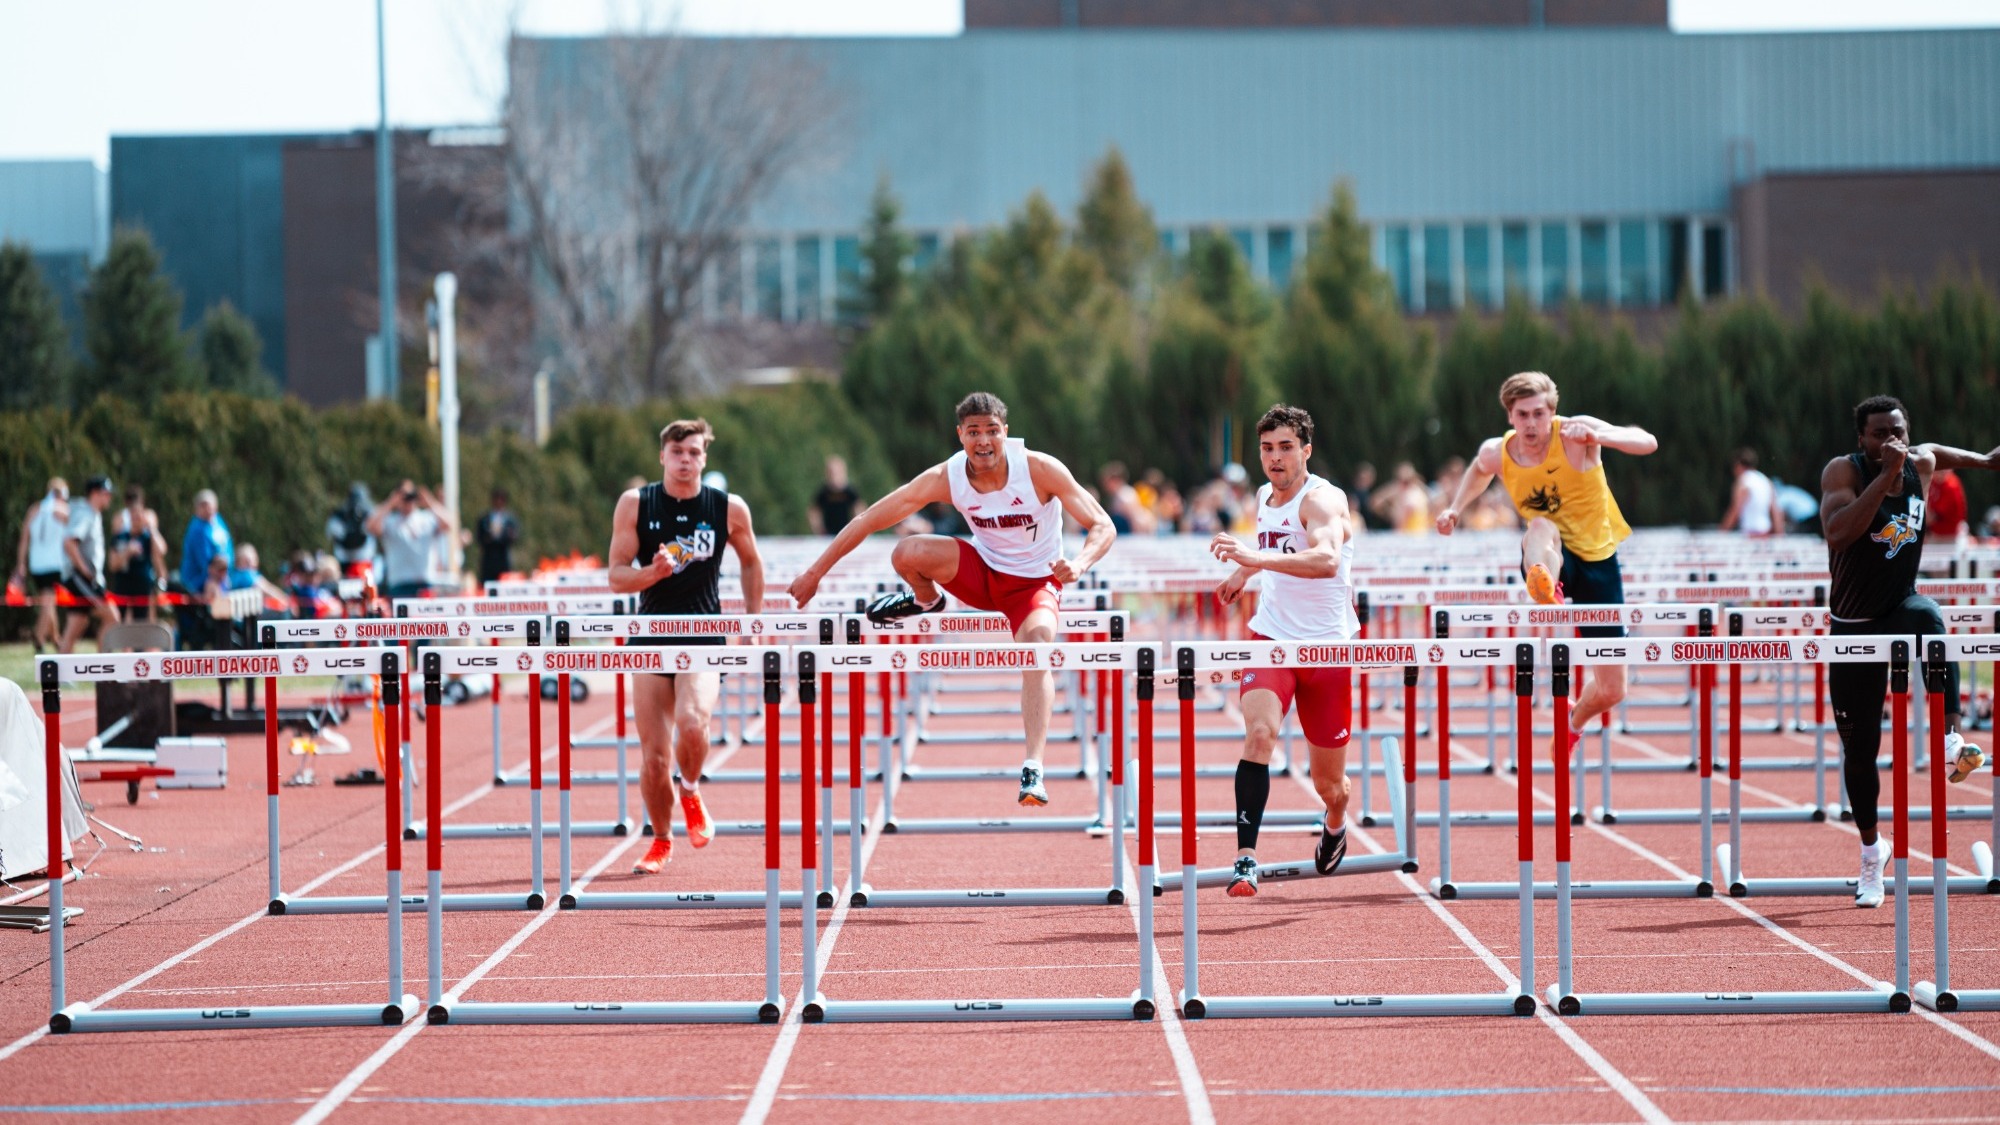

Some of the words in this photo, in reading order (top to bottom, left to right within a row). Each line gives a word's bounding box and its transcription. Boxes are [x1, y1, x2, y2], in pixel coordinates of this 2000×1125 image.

[1911, 503, 1921, 525] 4
[1026, 524, 1038, 542] 7
[698, 532, 710, 552] 8
[1282, 537, 1297, 554] 6
[1461, 613, 1494, 621] UCS
[1528, 609, 1570, 624] SOUTH
[1571, 609, 1622, 623] DAKOTA
[1655, 611, 1687, 620] UCS
[1755, 616, 1788, 624] UCS
[1950, 614, 1982, 622] UCS
[581, 624, 614, 632] UCS
[649, 619, 691, 635] SOUTH
[692, 618, 742, 634] DAKOTA
[775, 622, 808, 631] UCS
[939, 617, 982, 633] SOUTH
[1066, 619, 1098, 627] UCS
[287, 628, 321, 636] UCS
[355, 623, 397, 638] SOUTH
[399, 621, 449, 637] DAKOTA
[482, 624, 515, 633] UCS
[1297, 645, 1352, 665] SOUTH
[1352, 644, 1417, 664] DAKOTA
[1460, 648, 1501, 658] UCS
[1585, 648, 1627, 657] UCS
[1671, 641, 1726, 661] SOUTH
[1727, 640, 1792, 661] DAKOTA
[1835, 645, 1876, 655] UCS
[1961, 645, 2000, 654] UCS
[707, 656, 748, 665] UCS
[831, 656, 872, 665] UCS
[919, 650, 973, 670] SOUTH
[974, 648, 1038, 669] DAKOTA
[1081, 653, 1122, 662] UCS
[1210, 651, 1252, 661] UCS
[161, 656, 215, 677] SOUTH
[217, 655, 281, 676] DAKOTA
[324, 658, 366, 668] UCS
[457, 657, 498, 666] UCS
[544, 651, 598, 672] SOUTH
[600, 651, 664, 672] DAKOTA
[74, 664, 115, 674] UCS
[1261, 867, 1300, 879] UCS
[677, 894, 716, 902] UCS
[954, 1001, 1004, 1011] UCS
[1333, 996, 1384, 1006] UCS
[201, 1008, 251, 1019] UCS
